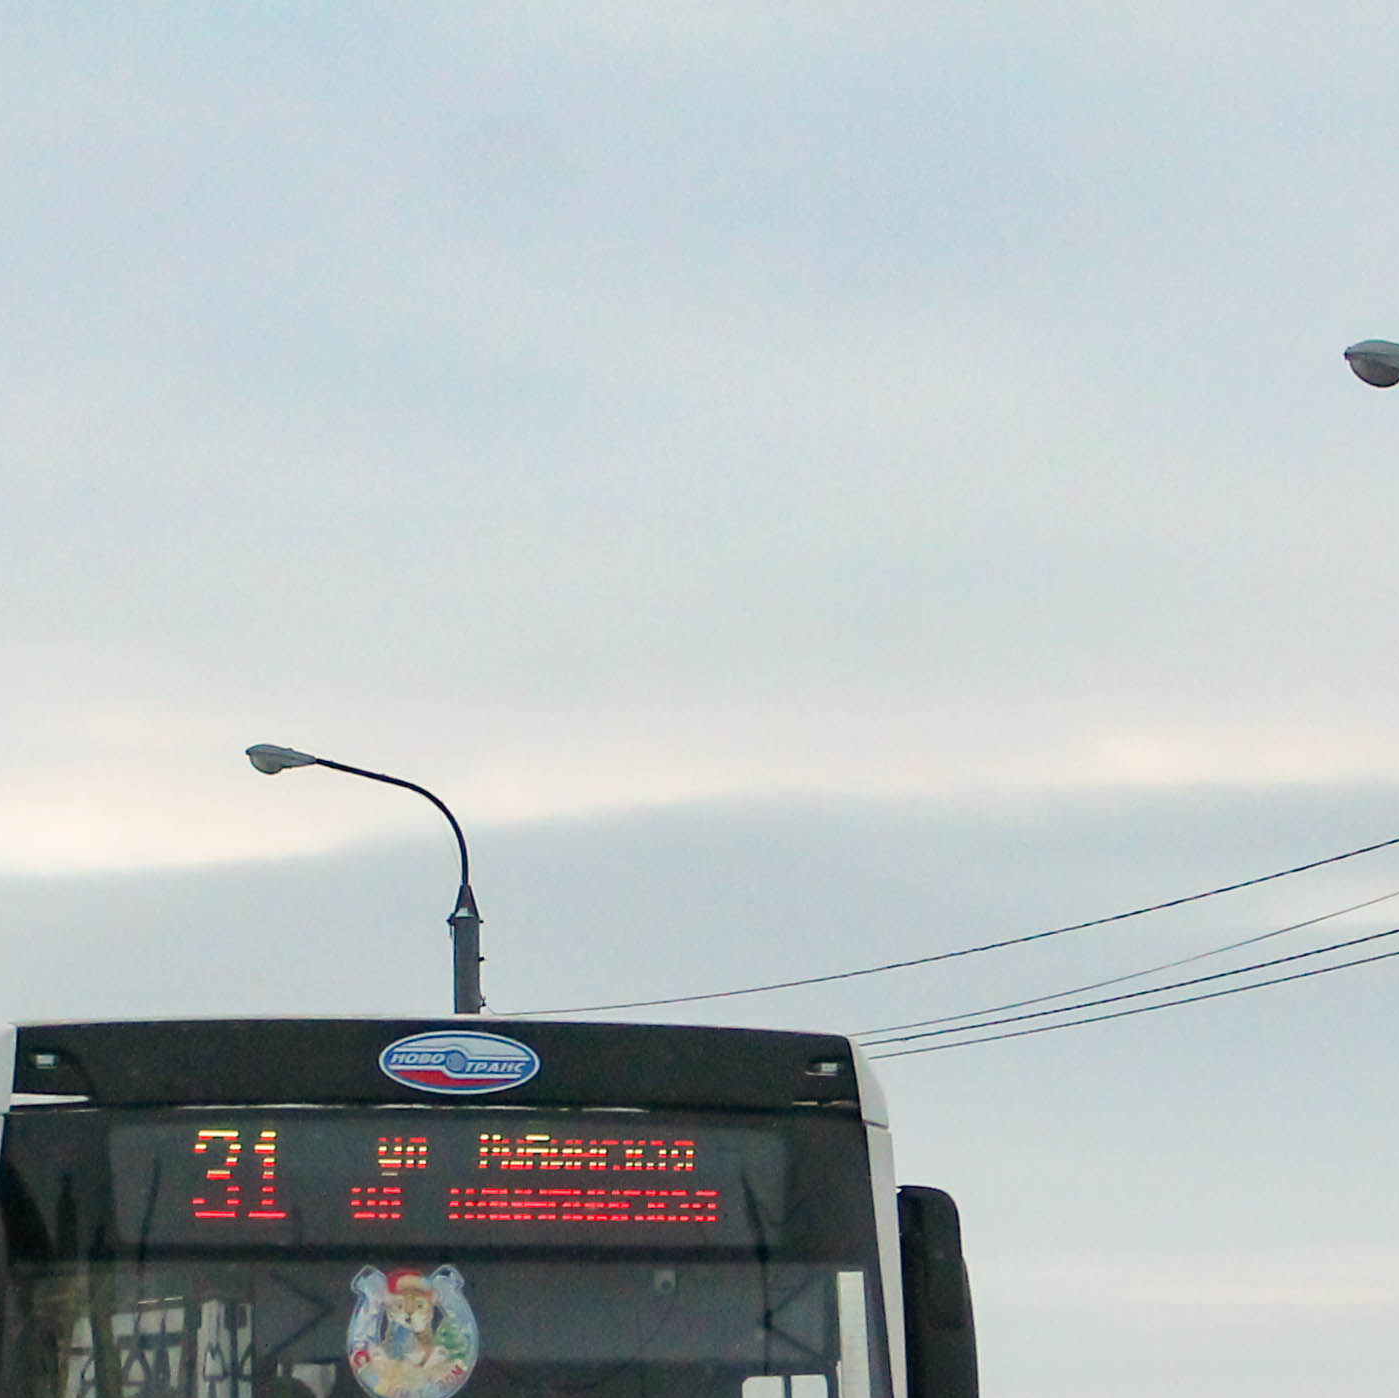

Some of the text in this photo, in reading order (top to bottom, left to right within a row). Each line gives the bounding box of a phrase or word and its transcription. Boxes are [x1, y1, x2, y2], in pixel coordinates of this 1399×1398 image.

[389, 1052, 526, 1074] НОВО ТРАНС
[191, 1129, 286, 1219] 31
